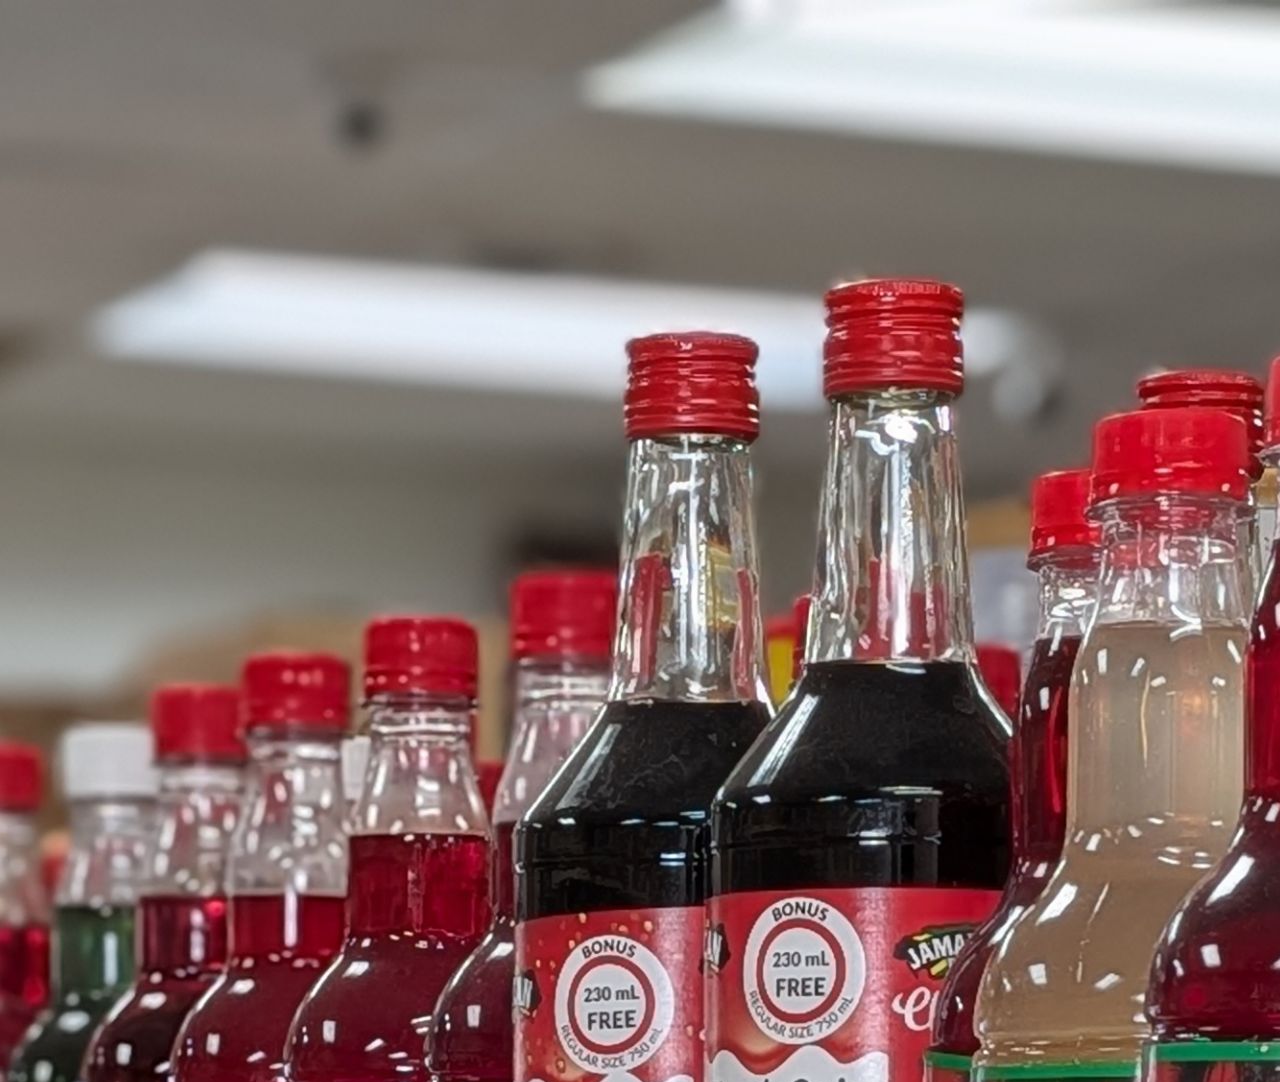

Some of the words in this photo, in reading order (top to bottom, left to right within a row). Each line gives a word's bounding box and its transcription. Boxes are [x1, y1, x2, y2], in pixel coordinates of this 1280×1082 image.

[772, 902, 829, 922] BONUS
[581, 939, 637, 959] BONUS
[772, 952, 801, 967] 230
[805, 951, 829, 966] mL
[583, 987, 612, 1003] 230
[615, 985, 640, 1001] mL
[775, 977, 826, 998] FREE
[587, 1010, 637, 1031] FREE
[749, 990, 786, 1037] REGULAR
[788, 1025, 814, 1038] SIZE
[816, 1012, 838, 1032] 750
[838, 997, 854, 1014] mL
[560, 1025, 599, 1067] REGULAR
[601, 1057, 626, 1069] SIZE
[629, 1042, 650, 1062] 750
[648, 1028, 663, 1045] mL
